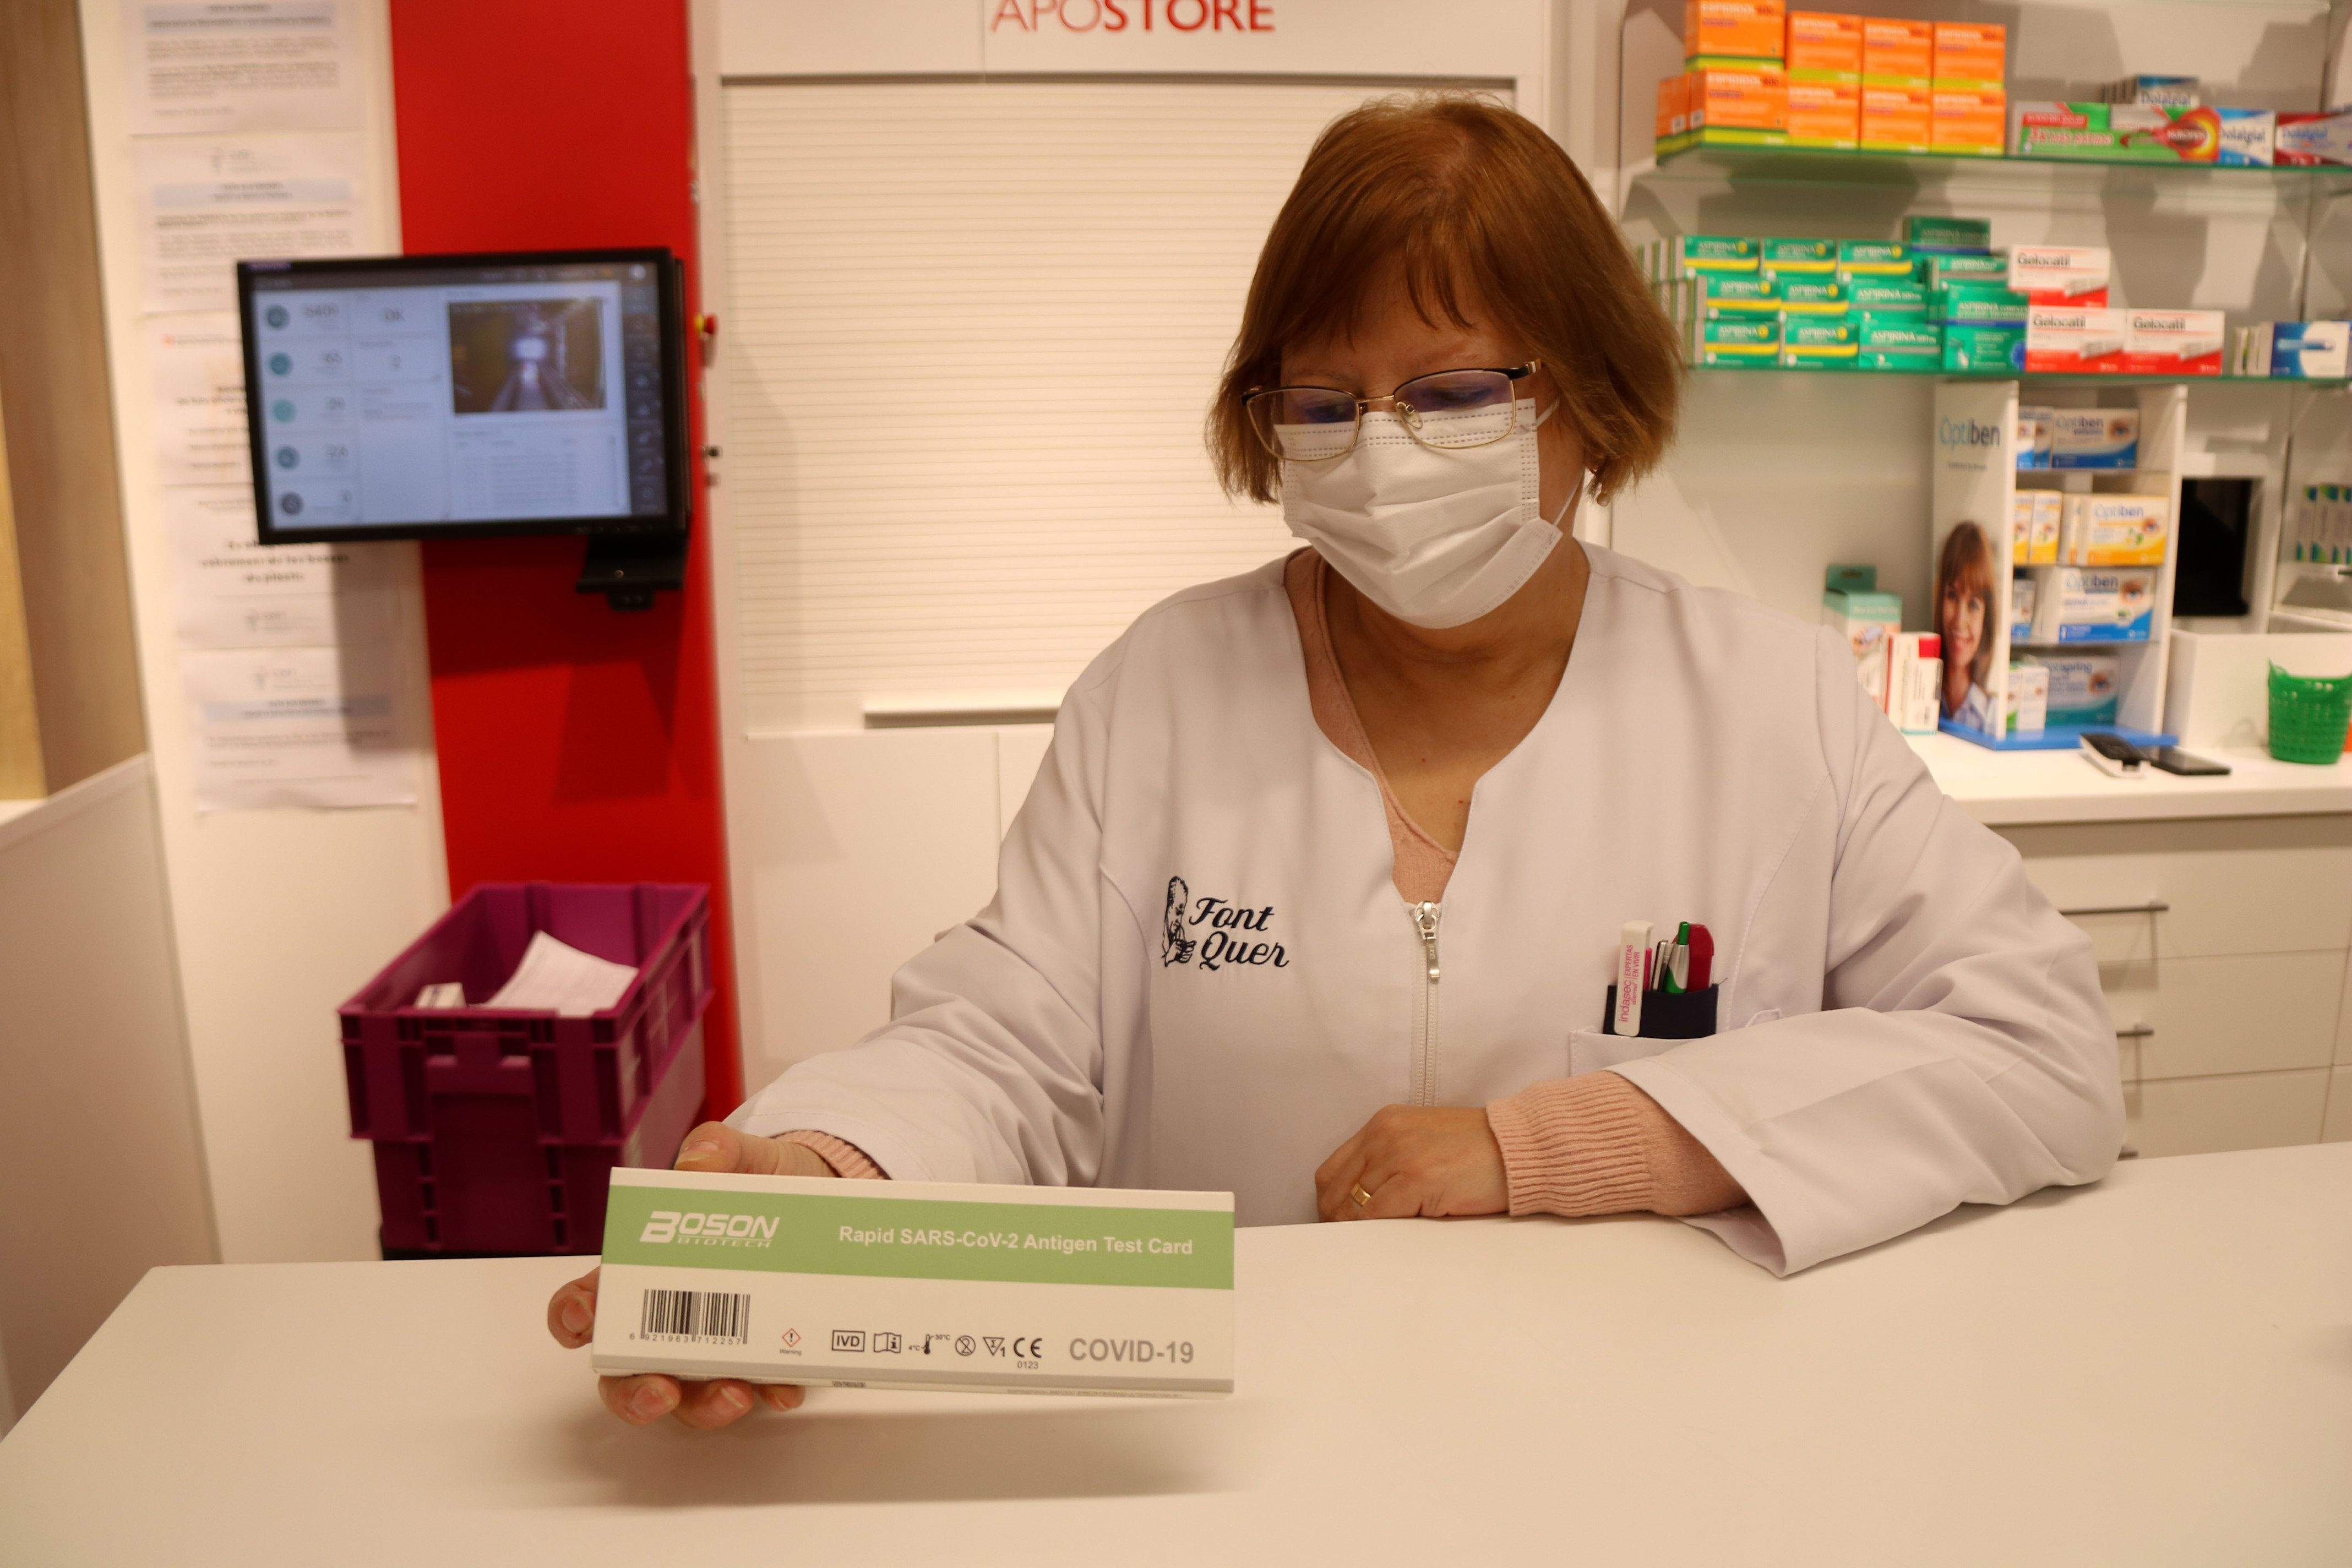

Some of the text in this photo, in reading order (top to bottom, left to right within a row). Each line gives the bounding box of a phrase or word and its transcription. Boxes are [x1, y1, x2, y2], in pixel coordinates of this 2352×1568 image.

[992, 0, 1275, 32] APOSTORE
[1698, 241, 1736, 251] ASPIRINA
[1778, 243, 1815, 253] ASPIRINA
[1854, 246, 1892, 255] ASPIRINA
[2018, 252, 2071, 266] Gelocatil
[1721, 280, 1760, 291] ASPIRINA
[1790, 285, 1827, 295] ASPIRINA
[1858, 287, 1902, 298] ASPIRINA
[1959, 301, 1999, 310] ASPIRINA
[2034, 315, 2086, 328] Gelocatil
[2133, 316, 2186, 330] Gelocatil
[1719, 324, 1758, 335] ASPIRINA
[1799, 326, 1838, 336] ASPIRINA
[1871, 330, 1916, 341] ASPIRINA
[1940, 416, 2001, 451] Optiben
[2094, 503, 2145, 519] Optiben
[1189, 897, 1275, 932] Font
[1199, 930, 1291, 971] Quer
[1632, 968, 1638, 977] EN
[1619, 944, 1634, 1022] indasec EXPERTAS
[639, 1210, 781, 1243] BOSON
[677, 1238, 771, 1249] BIOTECH
[839, 1226, 1193, 1255] Rapid SARS-CoV-2 Antigen Test Card
[836, 1335, 860, 1347] IVD
[1014, 1337, 1043, 1358] CE
[1070, 1338, 1194, 1364] COVID-19
[1016, 1360, 1039, 1369] 0123
